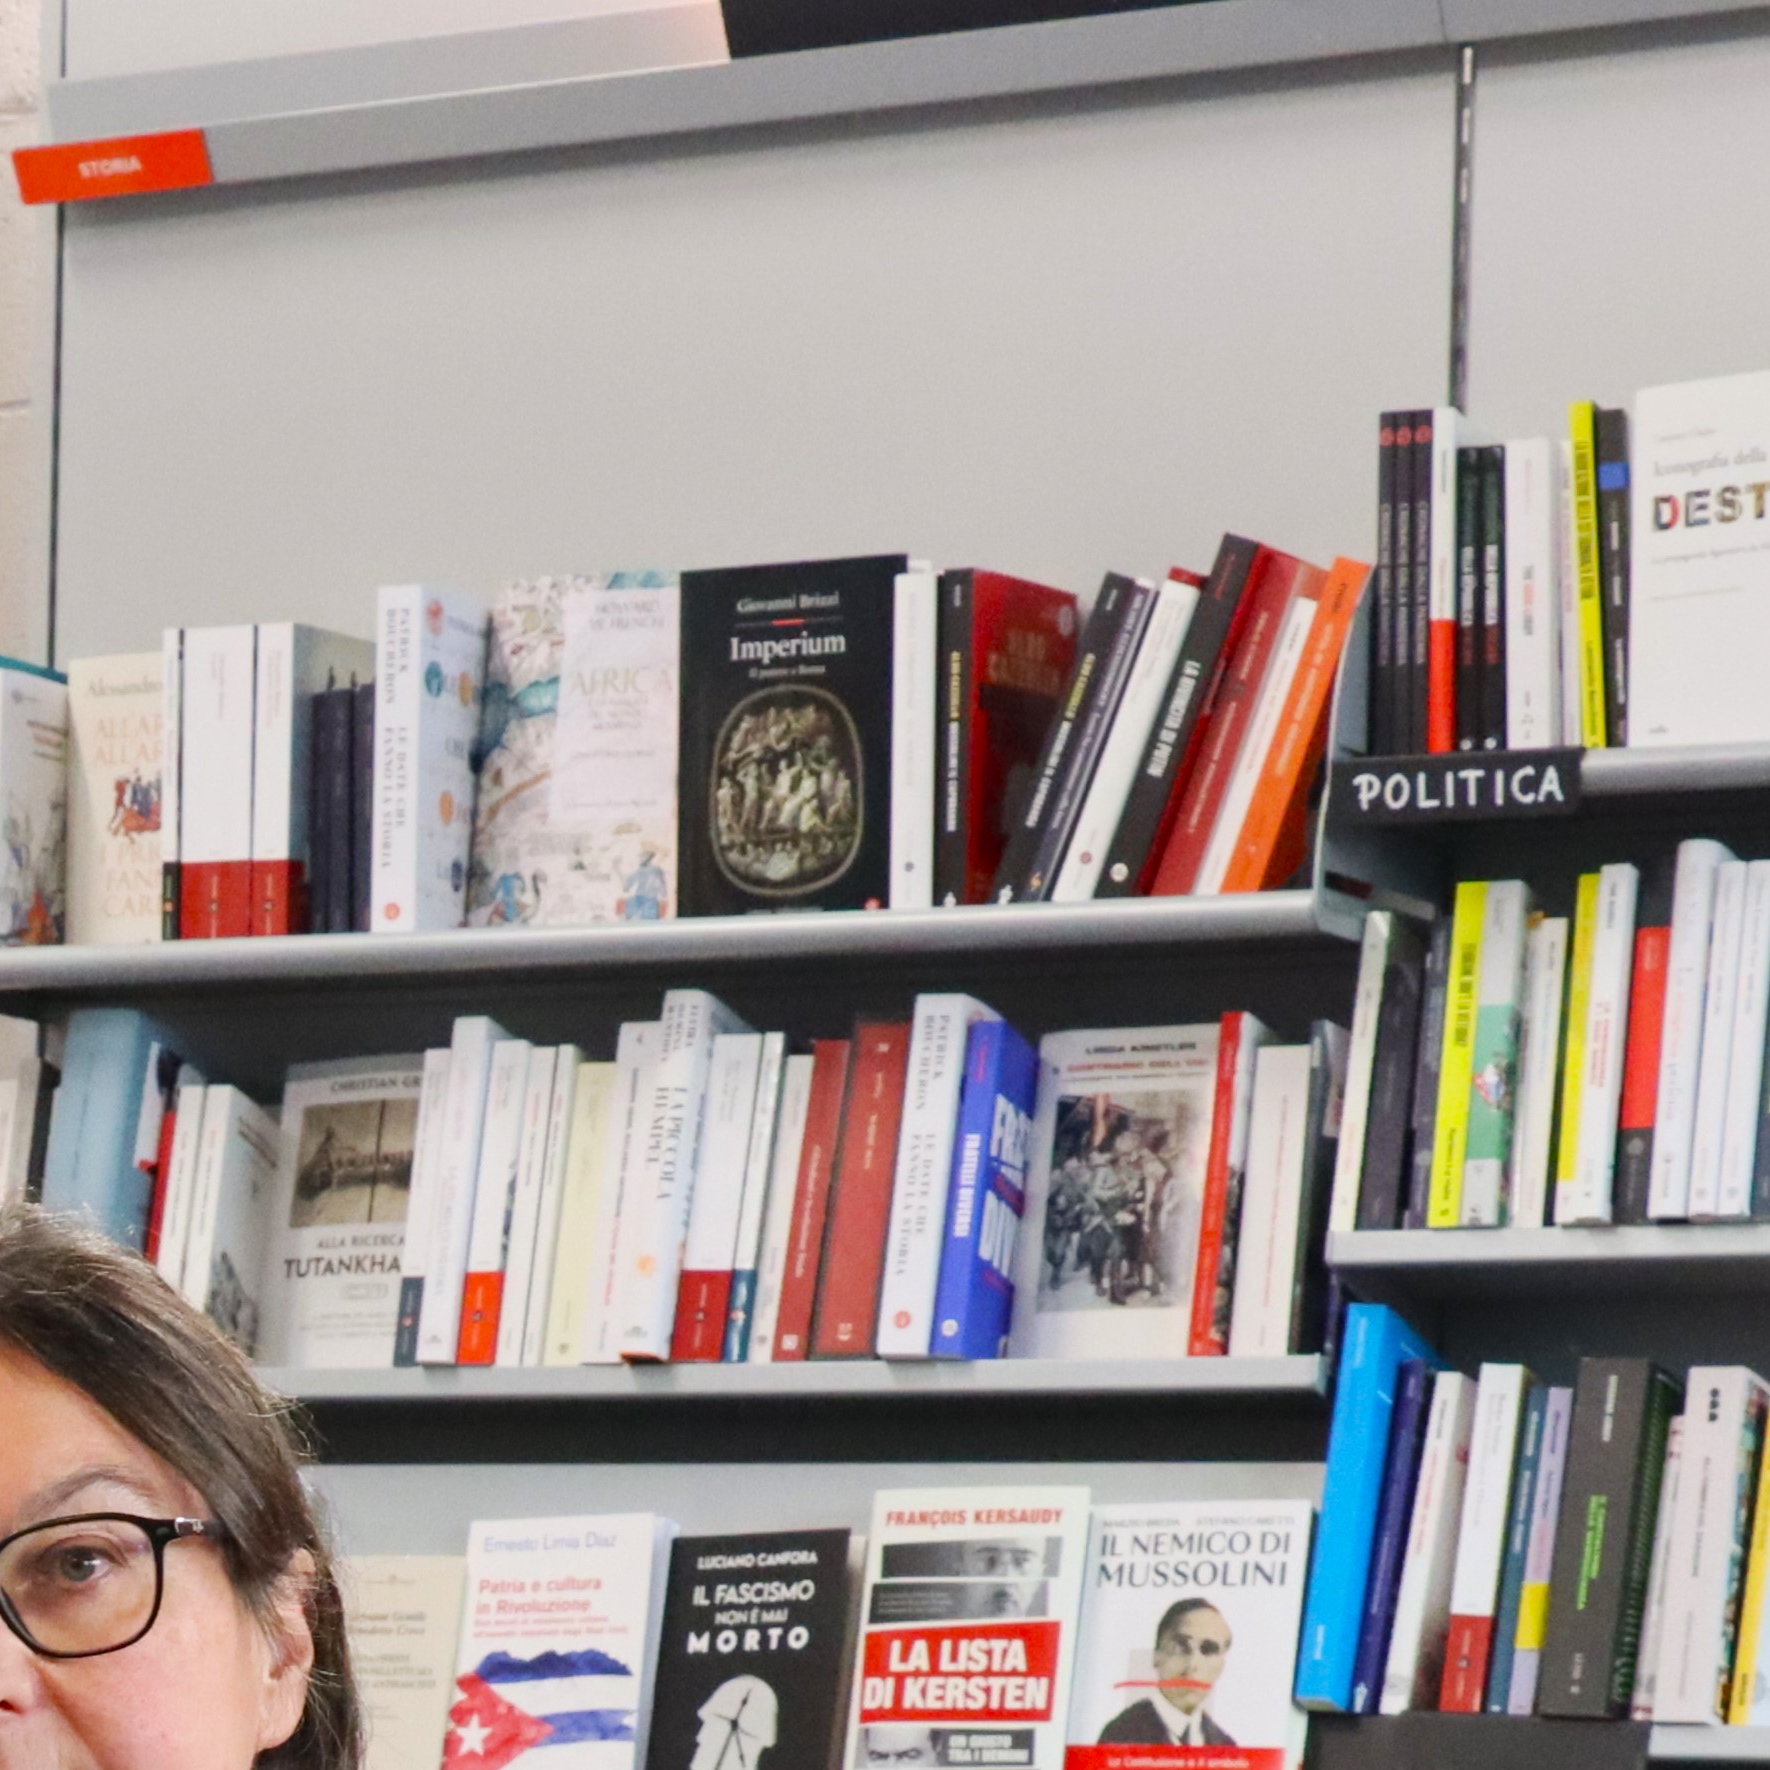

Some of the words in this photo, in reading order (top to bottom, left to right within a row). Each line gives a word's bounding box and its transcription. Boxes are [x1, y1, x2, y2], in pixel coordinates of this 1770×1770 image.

[1734, 446, 1768, 465] della
[1653, 481, 1770, 532] DEST
[736, 596, 797, 614] Giovanni
[730, 631, 847, 665] Imperium
[1352, 764, 1565, 811] POLITICA
[284, 1253, 402, 1279] TUTANKHA
[886, 1510, 968, 1529] FRANÇOIS
[974, 1507, 1063, 1525] KERSAUDY
[1099, 1534, 1123, 1557] IL
[1128, 1530, 1253, 1556] NEMICO
[1259, 1530, 1291, 1555] DI
[696, 1553, 756, 1570] LUCIANO
[757, 1550, 818, 1567] CANFORA
[479, 1578, 526, 1594] Patria
[531, 1580, 541, 1593] e
[546, 1576, 603, 1592] cultura
[1096, 1561, 1288, 1588] MUSSOLINI
[692, 1585, 711, 1606] IL
[714, 1578, 816, 1605] FASCISMO
[496, 1598, 592, 1615] Rivoluzione
[714, 1609, 749, 1626] NON
[761, 1607, 789, 1624] MAI
[687, 1625, 810, 1655] MORTO
[888, 1639, 937, 1673] LA
[939, 1638, 1028, 1673] LISTA
[862, 1678, 895, 1710] DI
[902, 1677, 1050, 1711] KERSTEN
